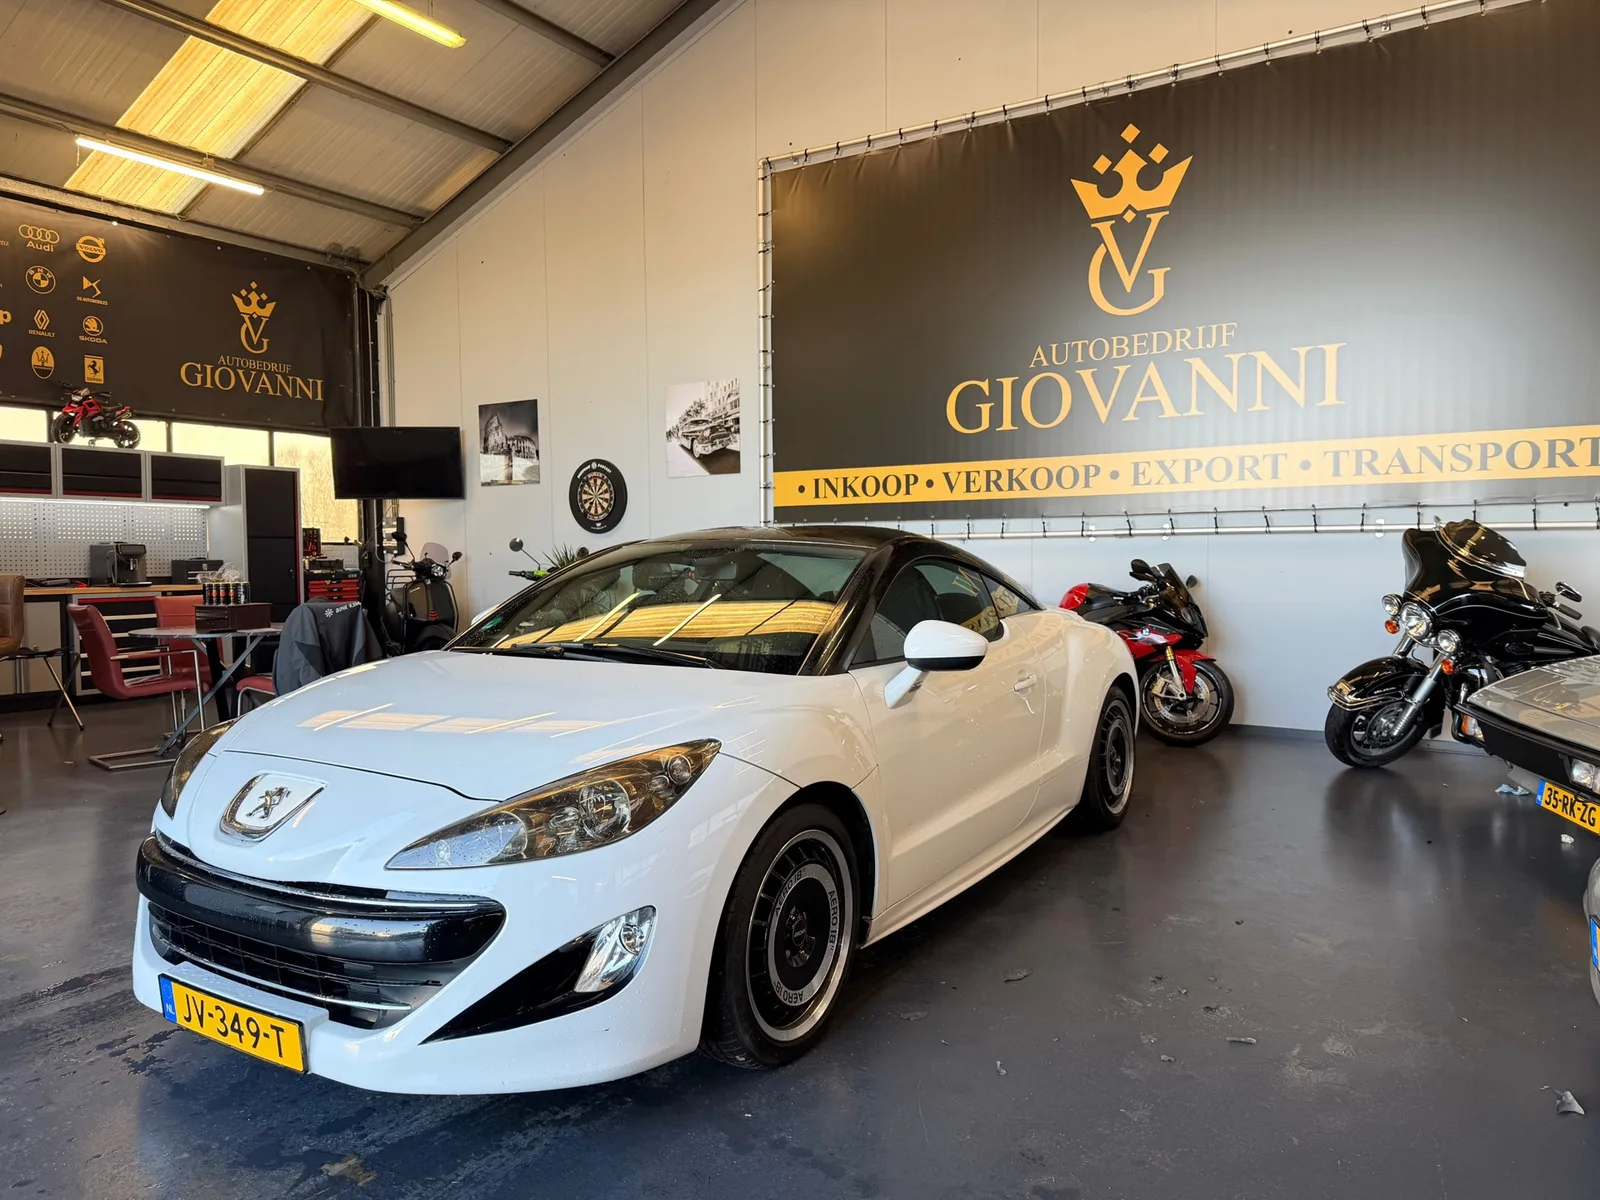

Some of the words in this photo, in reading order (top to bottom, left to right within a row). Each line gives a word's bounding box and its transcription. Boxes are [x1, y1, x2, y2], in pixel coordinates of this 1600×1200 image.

[26, 240, 54, 252] Audi
[79, 244, 104, 254] VOLVO
[28, 329, 56, 338] RENAULT
[1028, 321, 1238, 369] AUTOBEDRIJF
[180, 361, 324, 401] GIOVANNI
[217, 355, 292, 374] AUTOBEDRIJF
[945, 342, 1347, 434] GIOVANNI
[812, 473, 920, 500] INKOOP
[941, 464, 1102, 494] VERKOOP
[1130, 453, 1289, 487] EXPORT
[1323, 436, 1600, 477] TRANSPORT
[1544, 787, 1597, 827] 35-RK-ZG
[165, 1003, 175, 1015] NL
[183, 993, 285, 1058] JV-349-T
